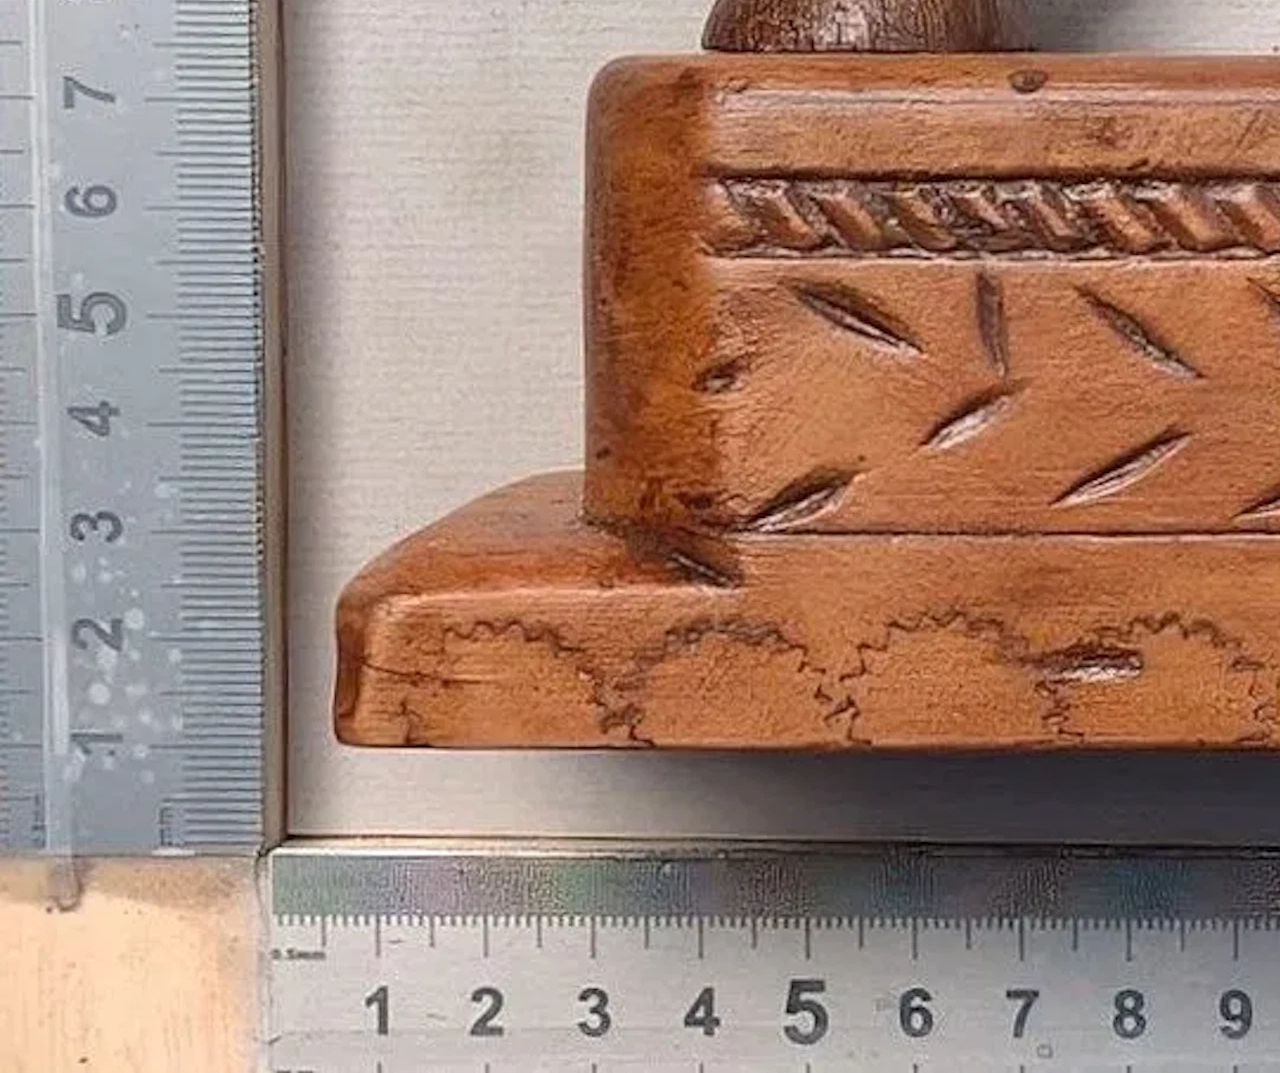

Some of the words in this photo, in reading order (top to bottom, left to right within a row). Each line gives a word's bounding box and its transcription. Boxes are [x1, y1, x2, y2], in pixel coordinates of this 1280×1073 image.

[63, 75, 116, 109] 7
[64, 183, 117, 218] 6
[57, 290, 128, 336] 5
[67, 400, 121, 437] 4
[70, 509, 123, 544] 3
[71, 617, 124, 653] 2
[71, 732, 124, 755] 1
[366, 986, 388, 1035] 1
[470, 987, 504, 1036] 2
[578, 988, 611, 1037] 3
[684, 987, 720, 1036] 4
[784, 979, 828, 1045] 5
[899, 988, 933, 1037] 6
[1006, 989, 1039, 1038] 7
[1113, 989, 1146, 1039] 8
[1220, 989, 1252, 1039] 9
